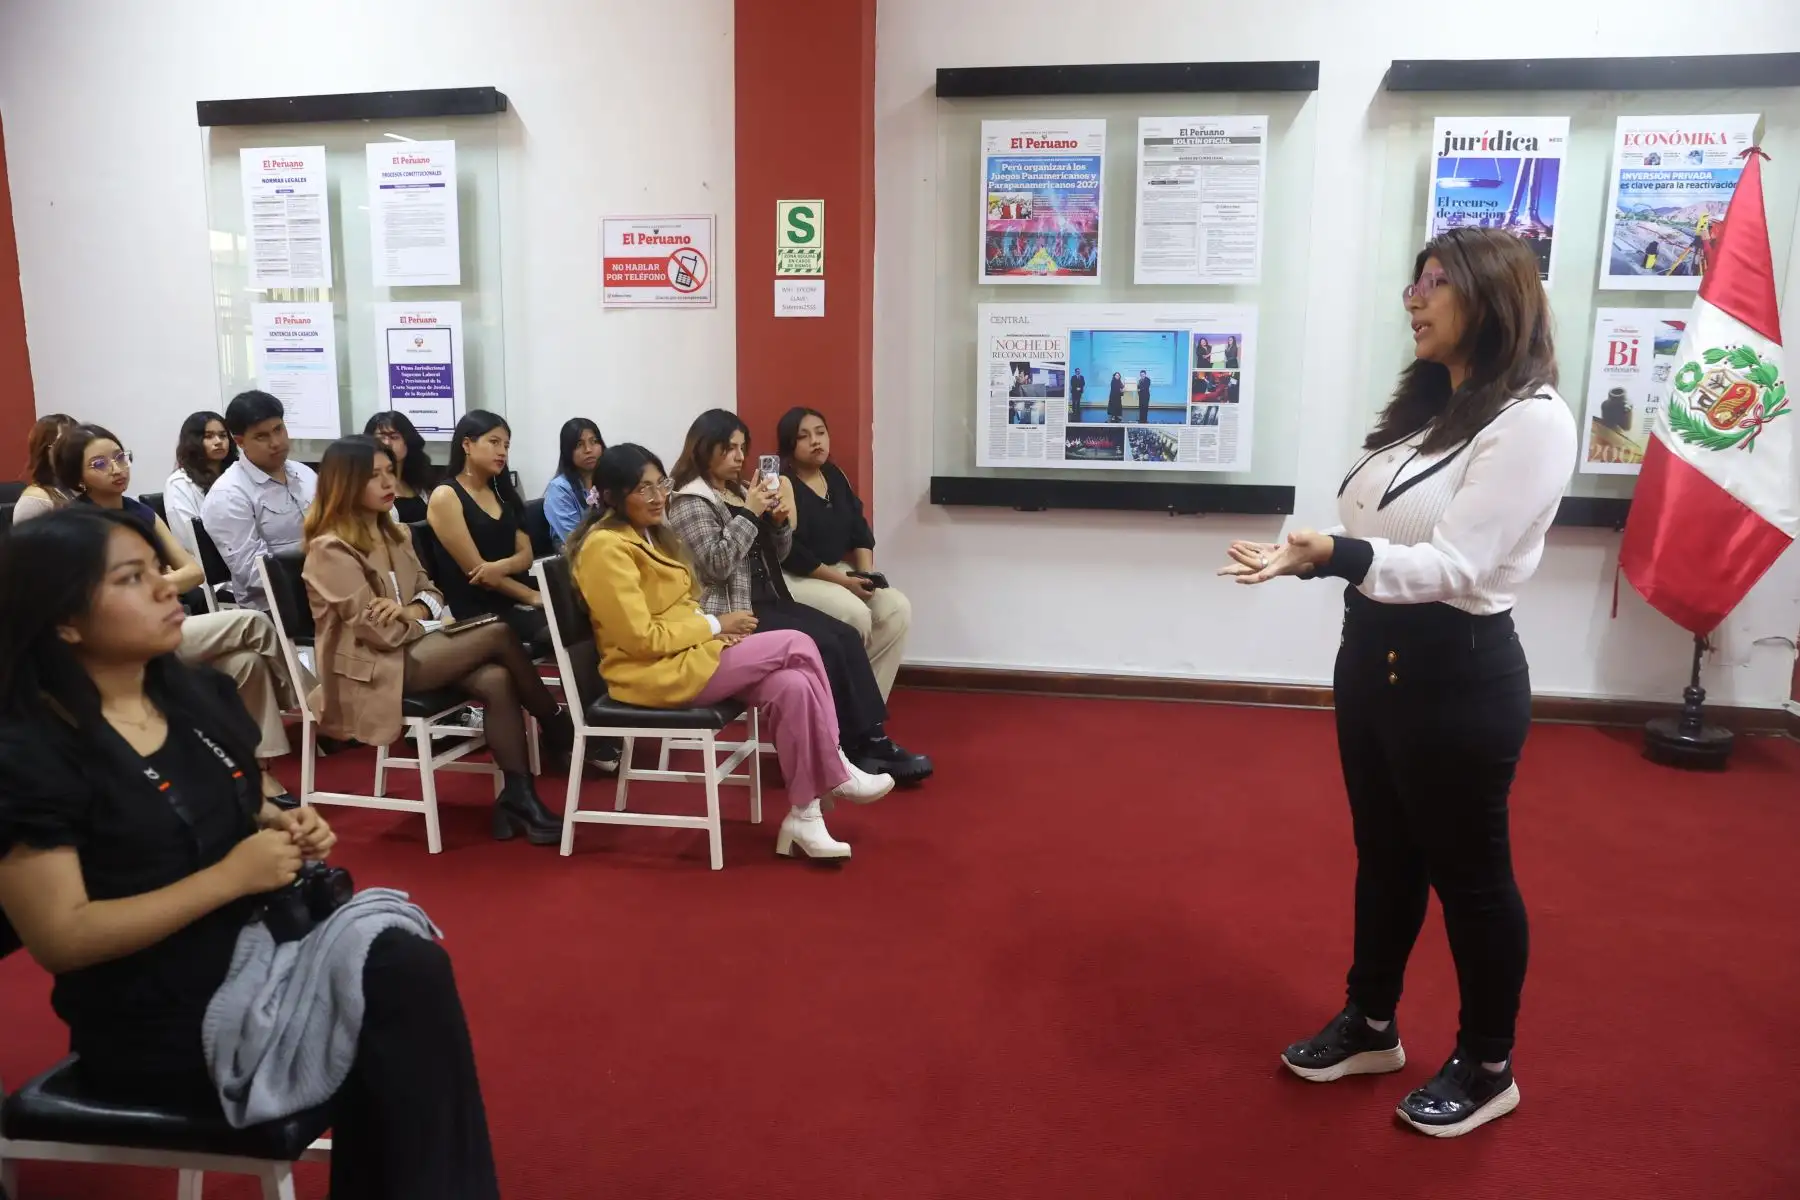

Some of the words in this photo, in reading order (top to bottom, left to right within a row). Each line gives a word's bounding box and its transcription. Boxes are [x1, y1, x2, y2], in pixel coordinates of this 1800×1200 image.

[1438, 130, 1539, 156] jurídica
[1624, 130, 1727, 146] ECONÓMIKA
[1011, 138, 1022, 149] El
[1026, 138, 1078, 149] Peruano
[263, 160, 270, 168] El
[272, 160, 304, 168] Peruano
[1002, 163, 1022, 171] Perú
[1023, 162, 1072, 172] organizará
[990, 172, 1020, 181] Juegos
[1021, 171, 1089, 180] Panamericanos
[1090, 173, 1096, 181] y
[1622, 171, 1671, 180] INVERSIÓN
[988, 181, 1075, 190] Parapanamericanos
[1076, 180, 1098, 189] 2027
[1655, 183, 1675, 192] para
[1437, 197, 1449, 207] El
[1452, 199, 1498, 207] recurso
[1436, 208, 1450, 218] de
[1453, 208, 1506, 219] casación
[787, 206, 815, 243] S
[622, 233, 634, 245] El
[638, 233, 691, 245] Peruano
[626, 272, 666, 280] TELÉFONO
[400, 316, 407, 324] El
[408, 316, 437, 324] Peruano
[990, 316, 1030, 324] CENTRAL
[996, 340, 1041, 350] NOCHE
[1044, 340, 1061, 350] DE
[992, 351, 1064, 359] RECONOCIMIENTO
[1608, 339, 1639, 366] Bi
[1647, 394, 1659, 402] La
